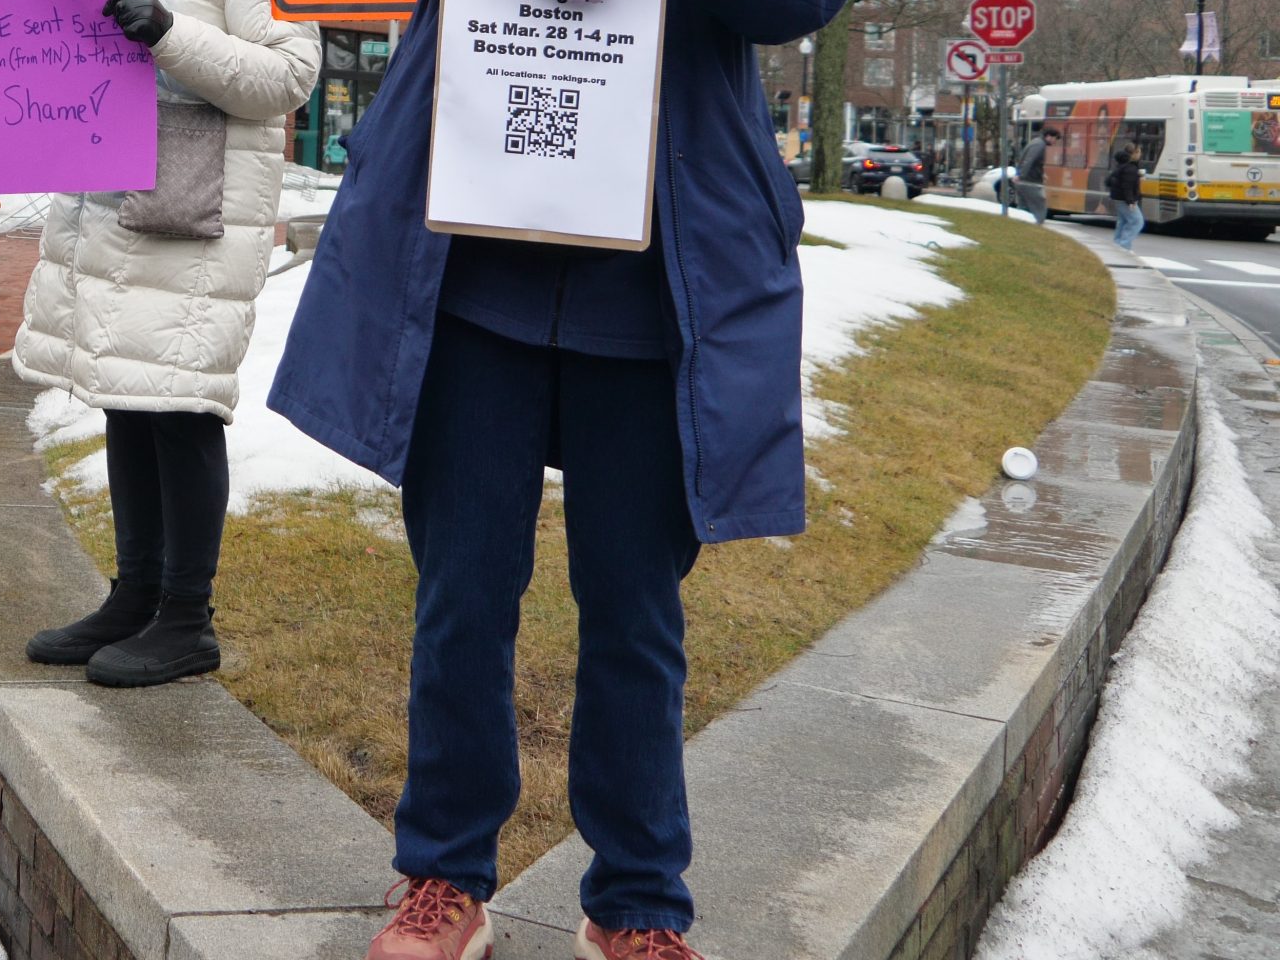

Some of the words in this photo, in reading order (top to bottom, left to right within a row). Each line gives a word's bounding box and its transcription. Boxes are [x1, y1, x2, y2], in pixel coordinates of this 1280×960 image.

[23, 6, 63, 35] sent
[72, 14, 85, 33] 5
[519, 4, 584, 21] Boston
[975, 6, 1031, 28] STOP
[467, 20, 498, 35] Sat
[502, 22, 540, 38] Mar.
[546, 26, 568, 39] 28
[574, 29, 602, 42] 1-4
[606, 32, 634, 46] pm
[41, 40, 71, 72] MN)
[76, 43, 87, 65] to
[88, 41, 123, 67] that
[473, 40, 537, 57] Boston
[543, 46, 624, 64] Common
[486, 68, 499, 76] All
[501, 69, 547, 80] locations:
[551, 73, 606, 86] nokings.org
[3, 79, 111, 145] Shame!
